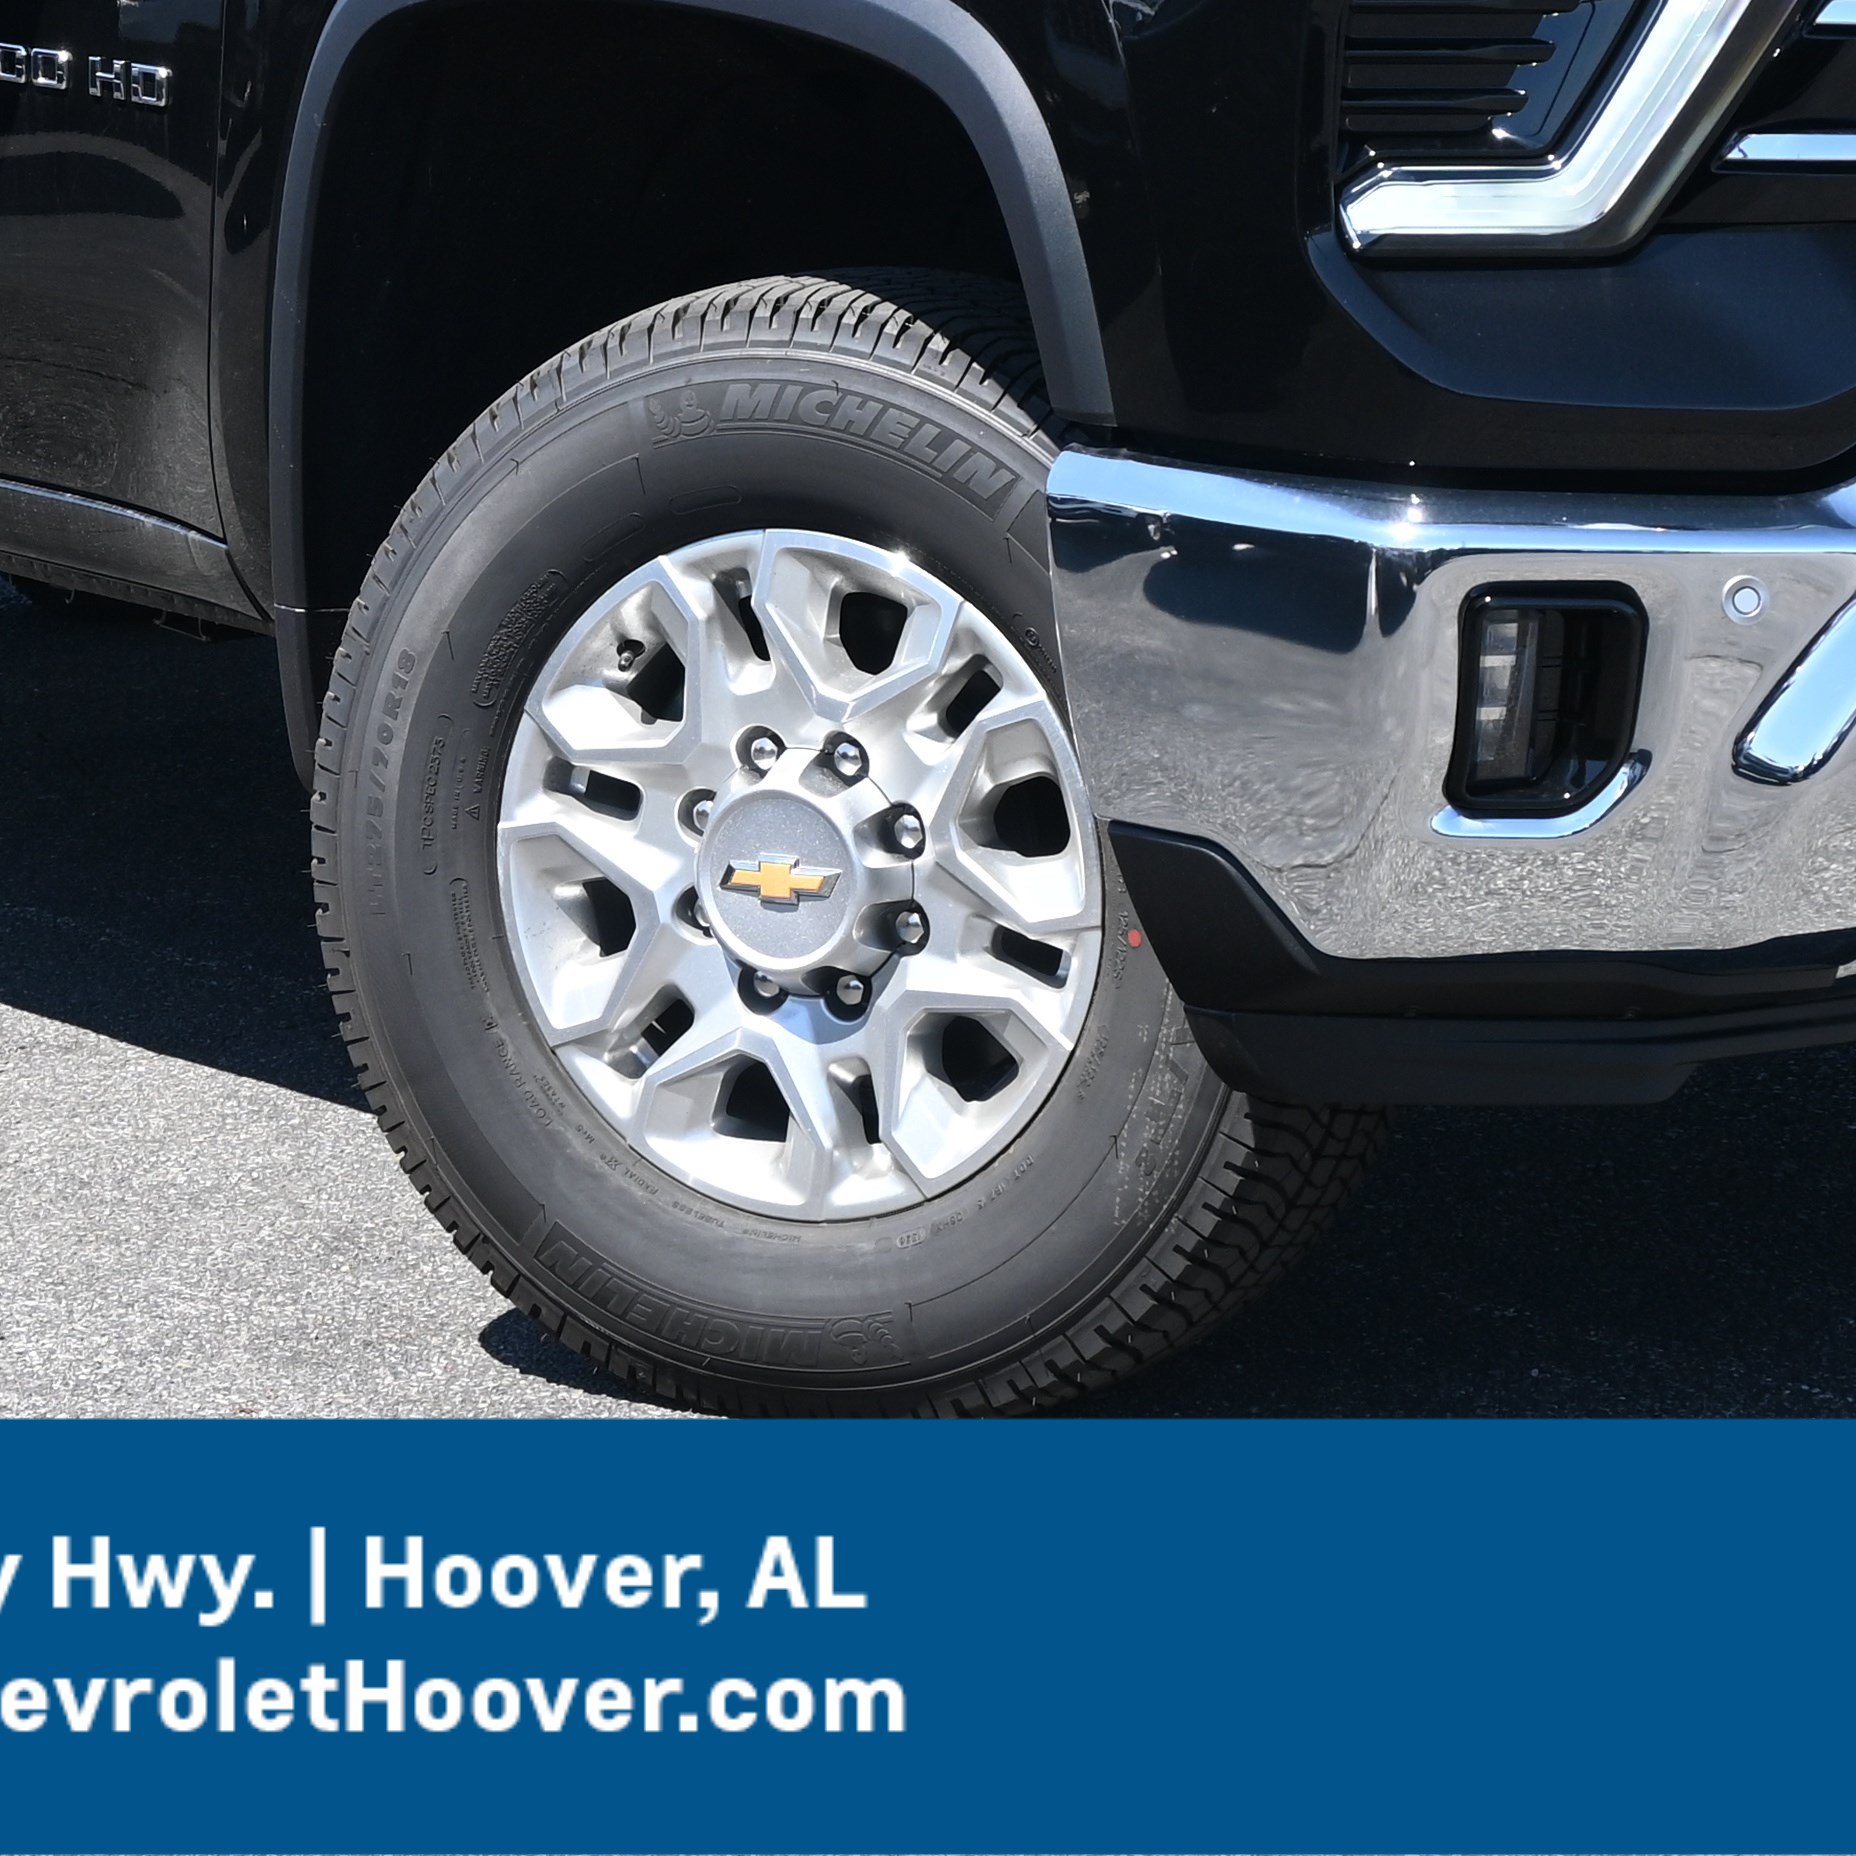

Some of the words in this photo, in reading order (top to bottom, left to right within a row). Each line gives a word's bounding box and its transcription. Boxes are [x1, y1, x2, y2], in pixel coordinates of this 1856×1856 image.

[88, 55, 173, 108] HD
[720, 382, 1017, 501] MICHELIN
[540, 1240, 824, 1367] MICHELIN
